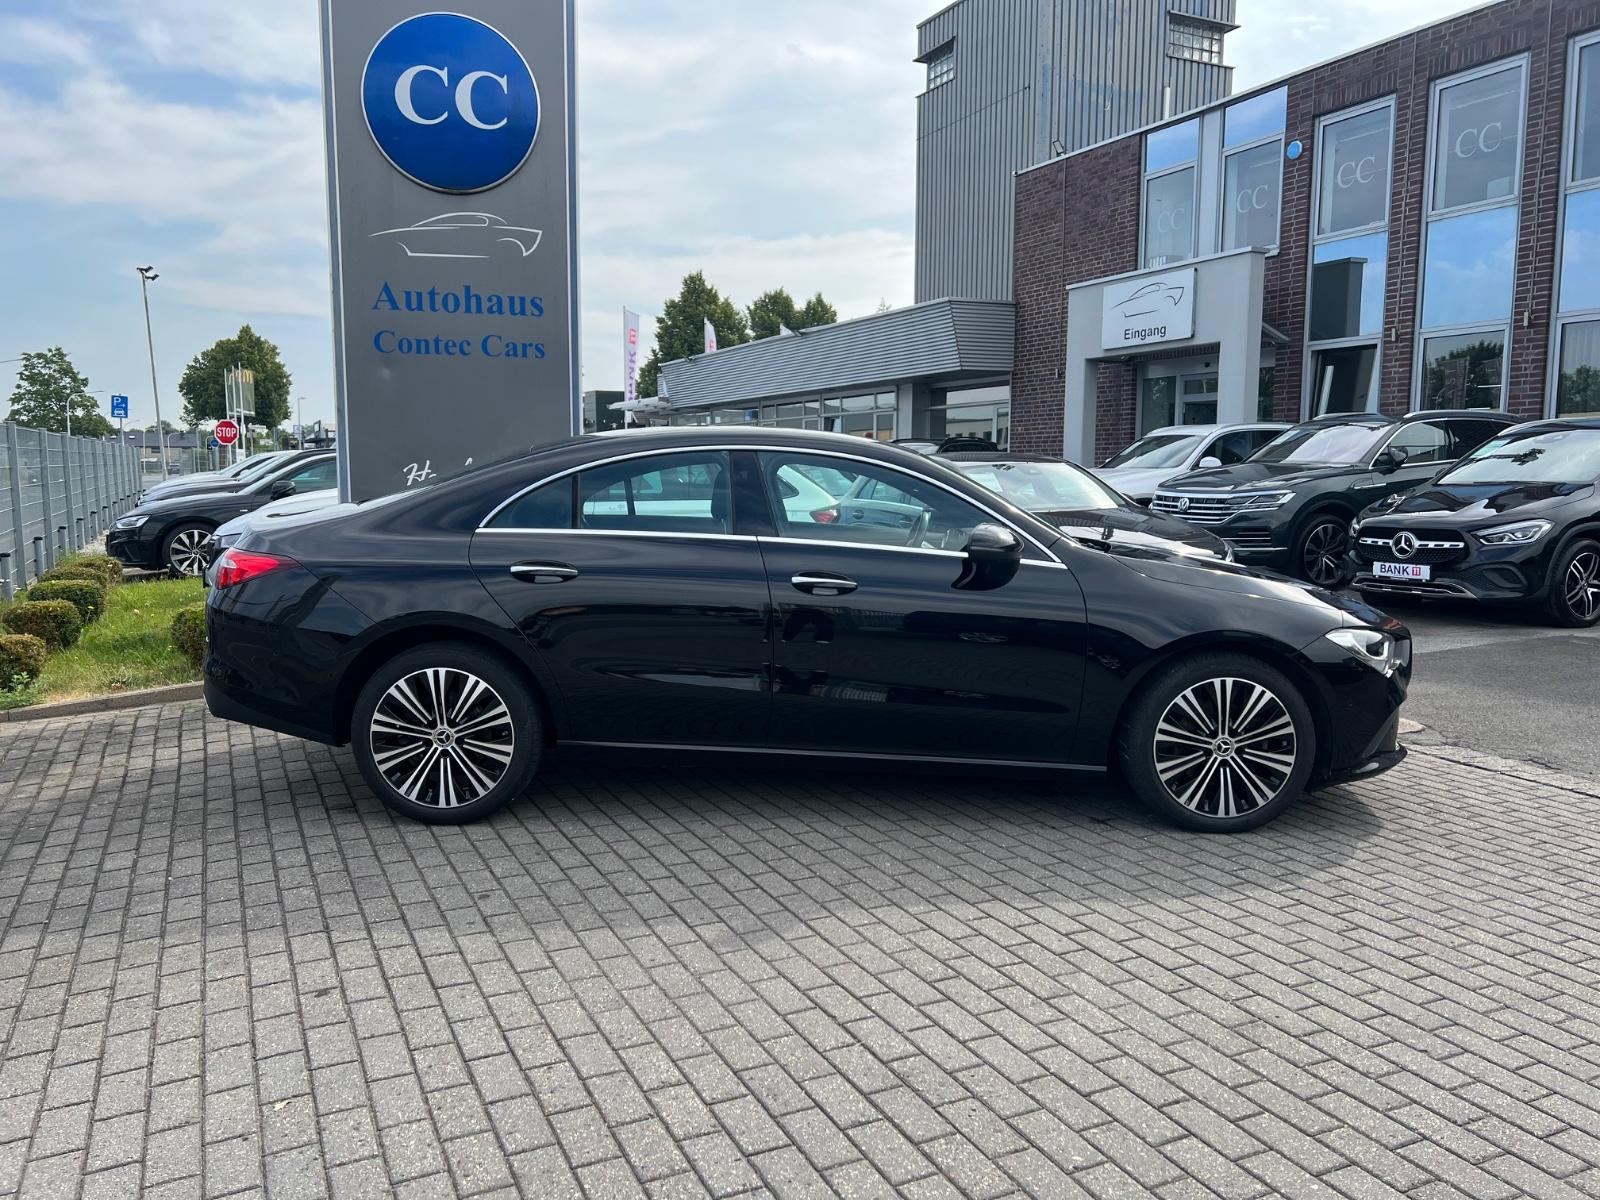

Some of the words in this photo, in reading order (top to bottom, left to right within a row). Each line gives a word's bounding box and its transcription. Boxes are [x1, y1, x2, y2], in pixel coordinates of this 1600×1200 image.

[394, 64, 508, 130] CC
[1455, 121, 1502, 158] CC
[1336, 156, 1376, 188] CC
[1236, 184, 1268, 214] CC
[371, 281, 544, 317] Autohaus
[372, 329, 471, 356] Contec
[480, 334, 546, 359] Cars
[1124, 325, 1167, 341] Eingang
[113, 396, 121, 406] P
[216, 427, 237, 438] STOP
[1380, 564, 1410, 576] BANK
